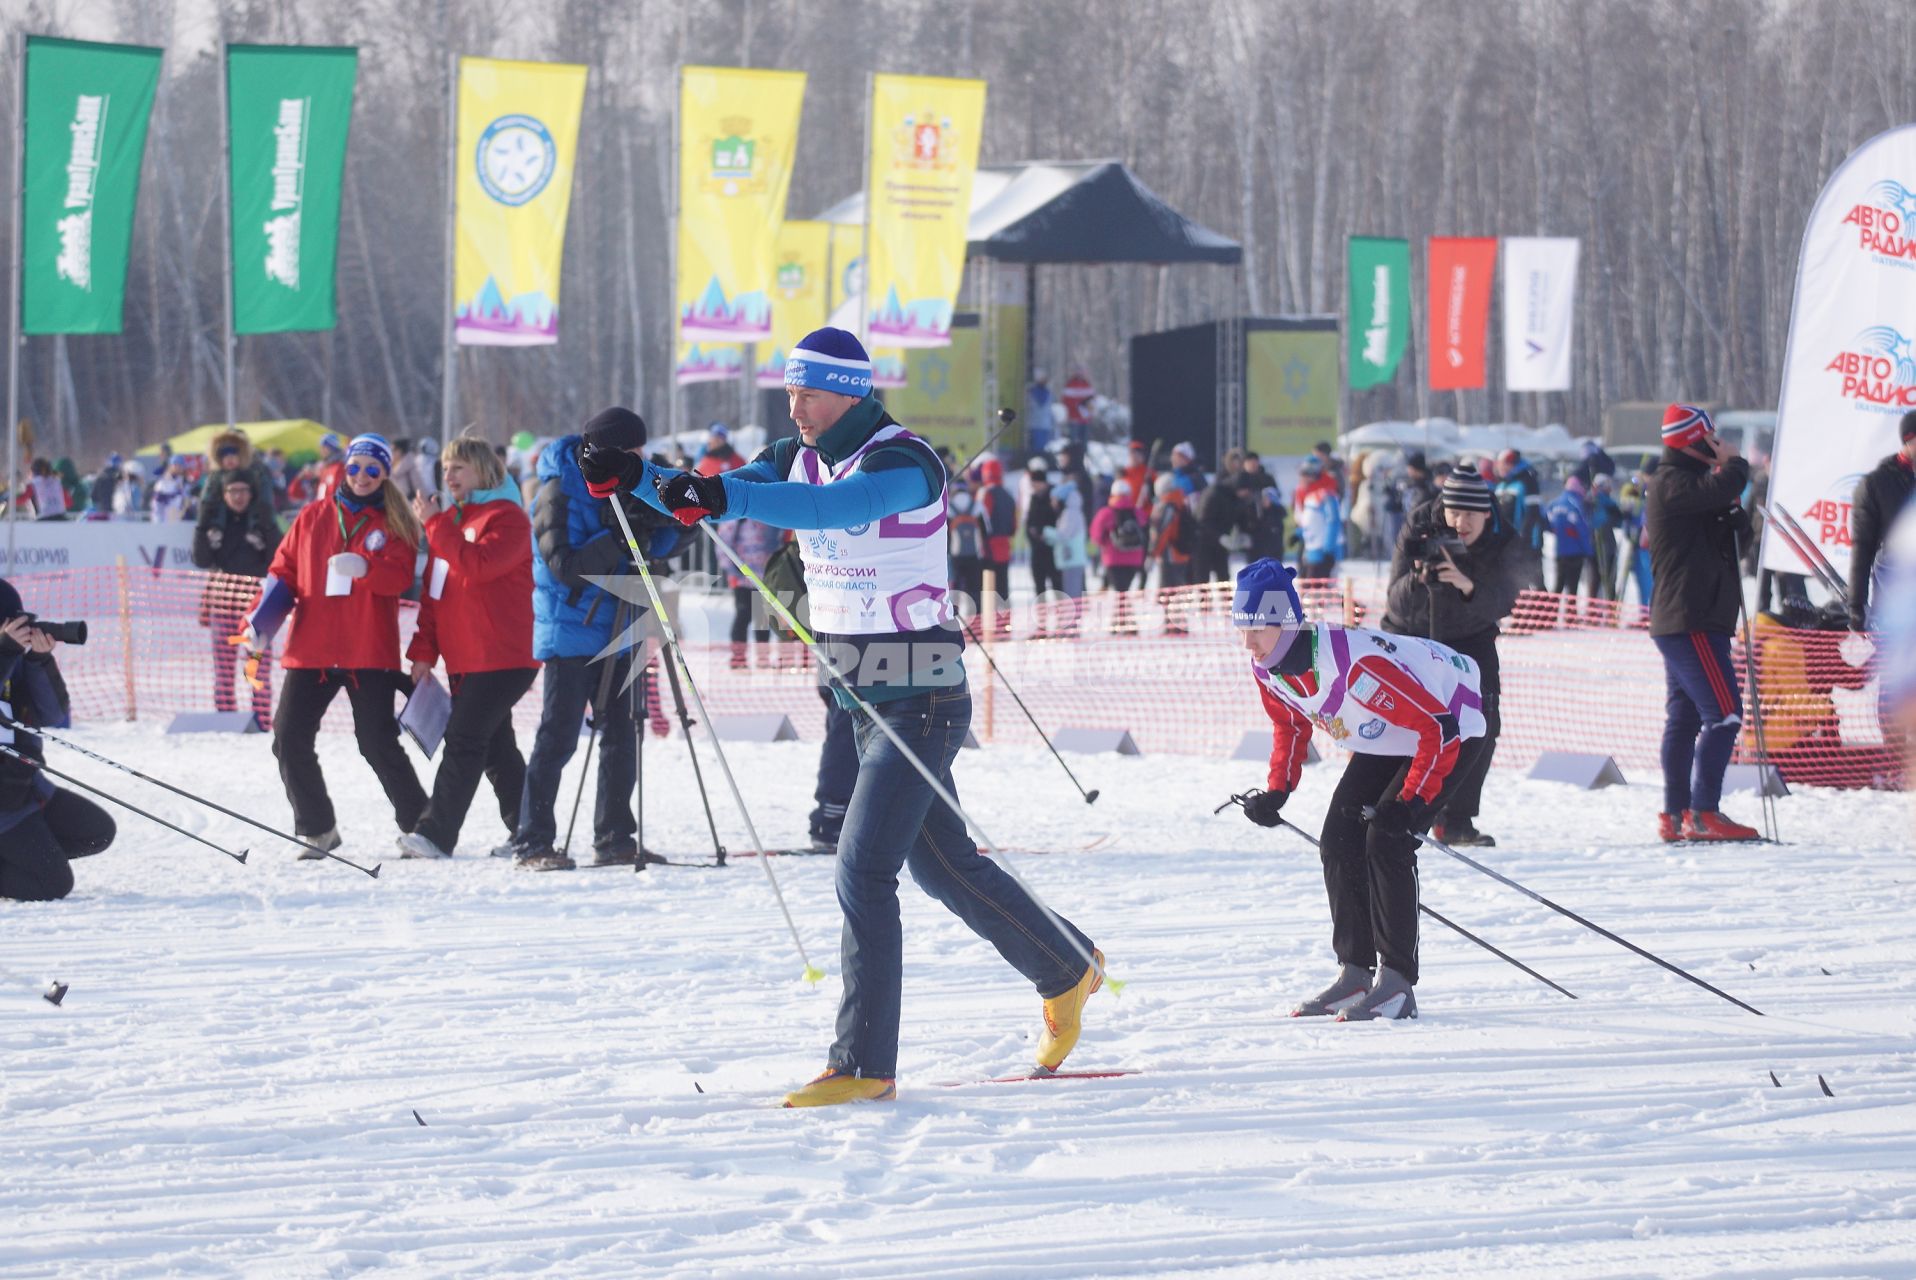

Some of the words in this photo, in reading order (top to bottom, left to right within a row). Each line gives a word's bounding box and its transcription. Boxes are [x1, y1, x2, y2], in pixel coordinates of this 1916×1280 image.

[1841, 204, 1900, 233] АВТО
[1860, 228, 1916, 260] РАДИ
[1825, 352, 1892, 380] АВТО
